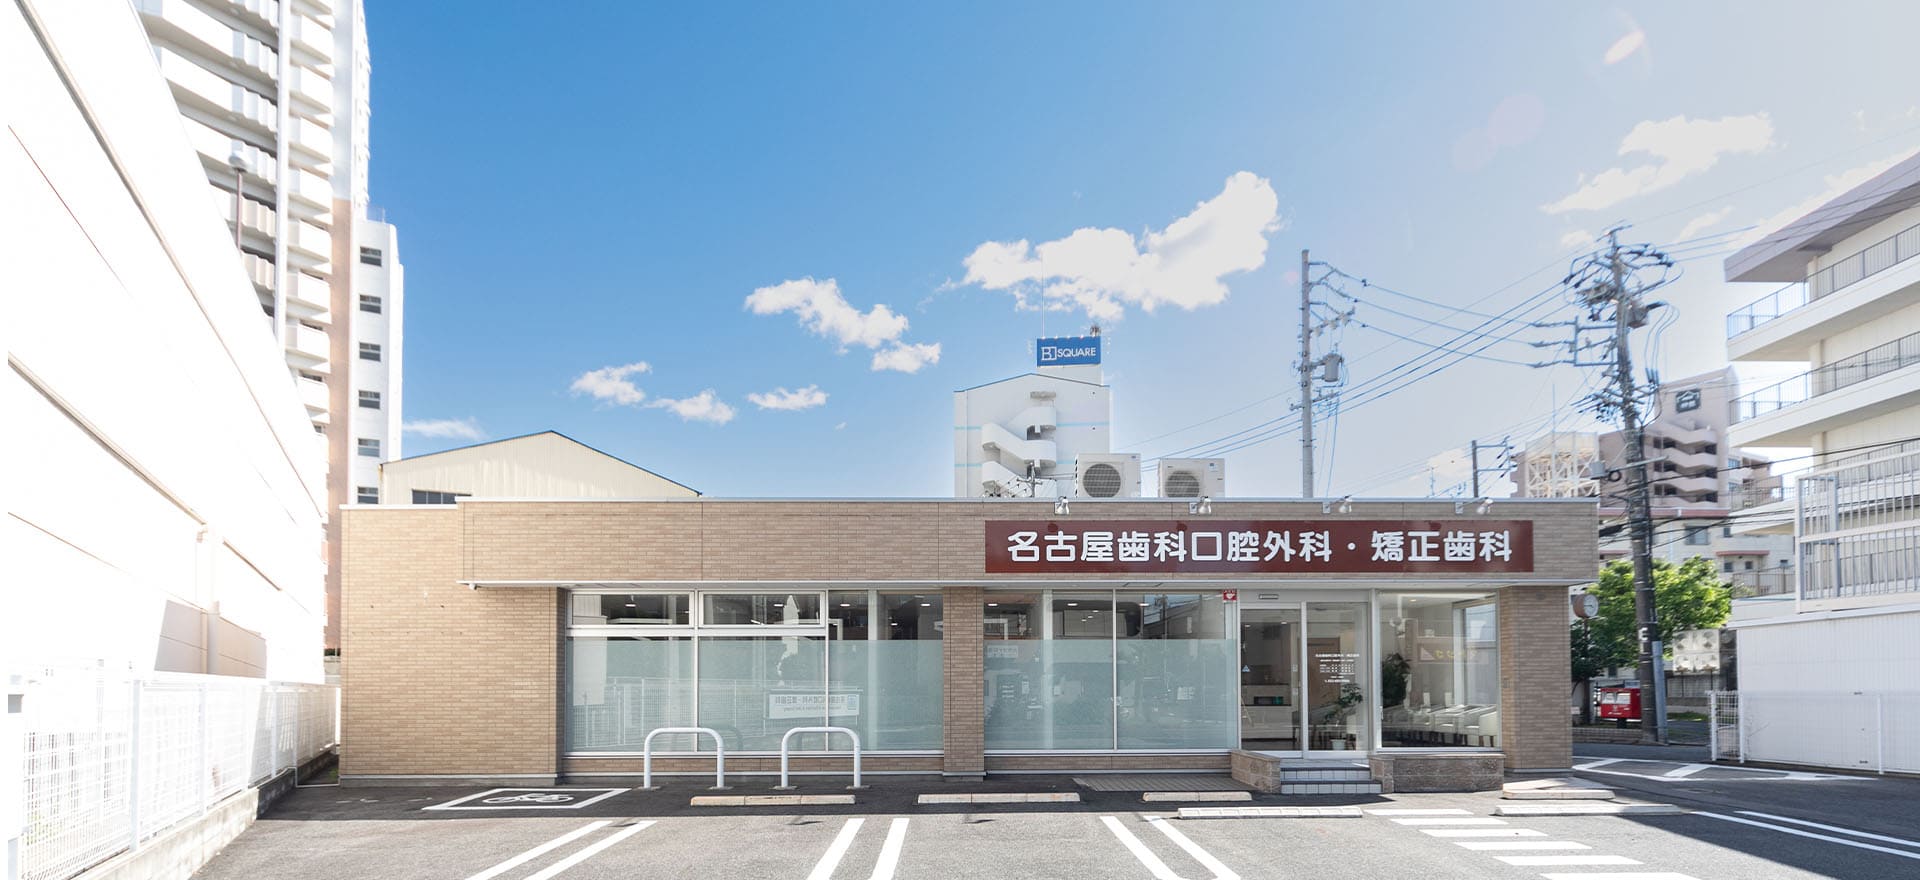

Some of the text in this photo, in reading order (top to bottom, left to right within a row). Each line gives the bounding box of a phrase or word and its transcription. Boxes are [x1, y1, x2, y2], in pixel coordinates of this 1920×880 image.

[1057, 347, 1096, 358] SQUARE
[1007, 530, 1513, 562] 名古屋歯科口腔外科・矯正歯科
